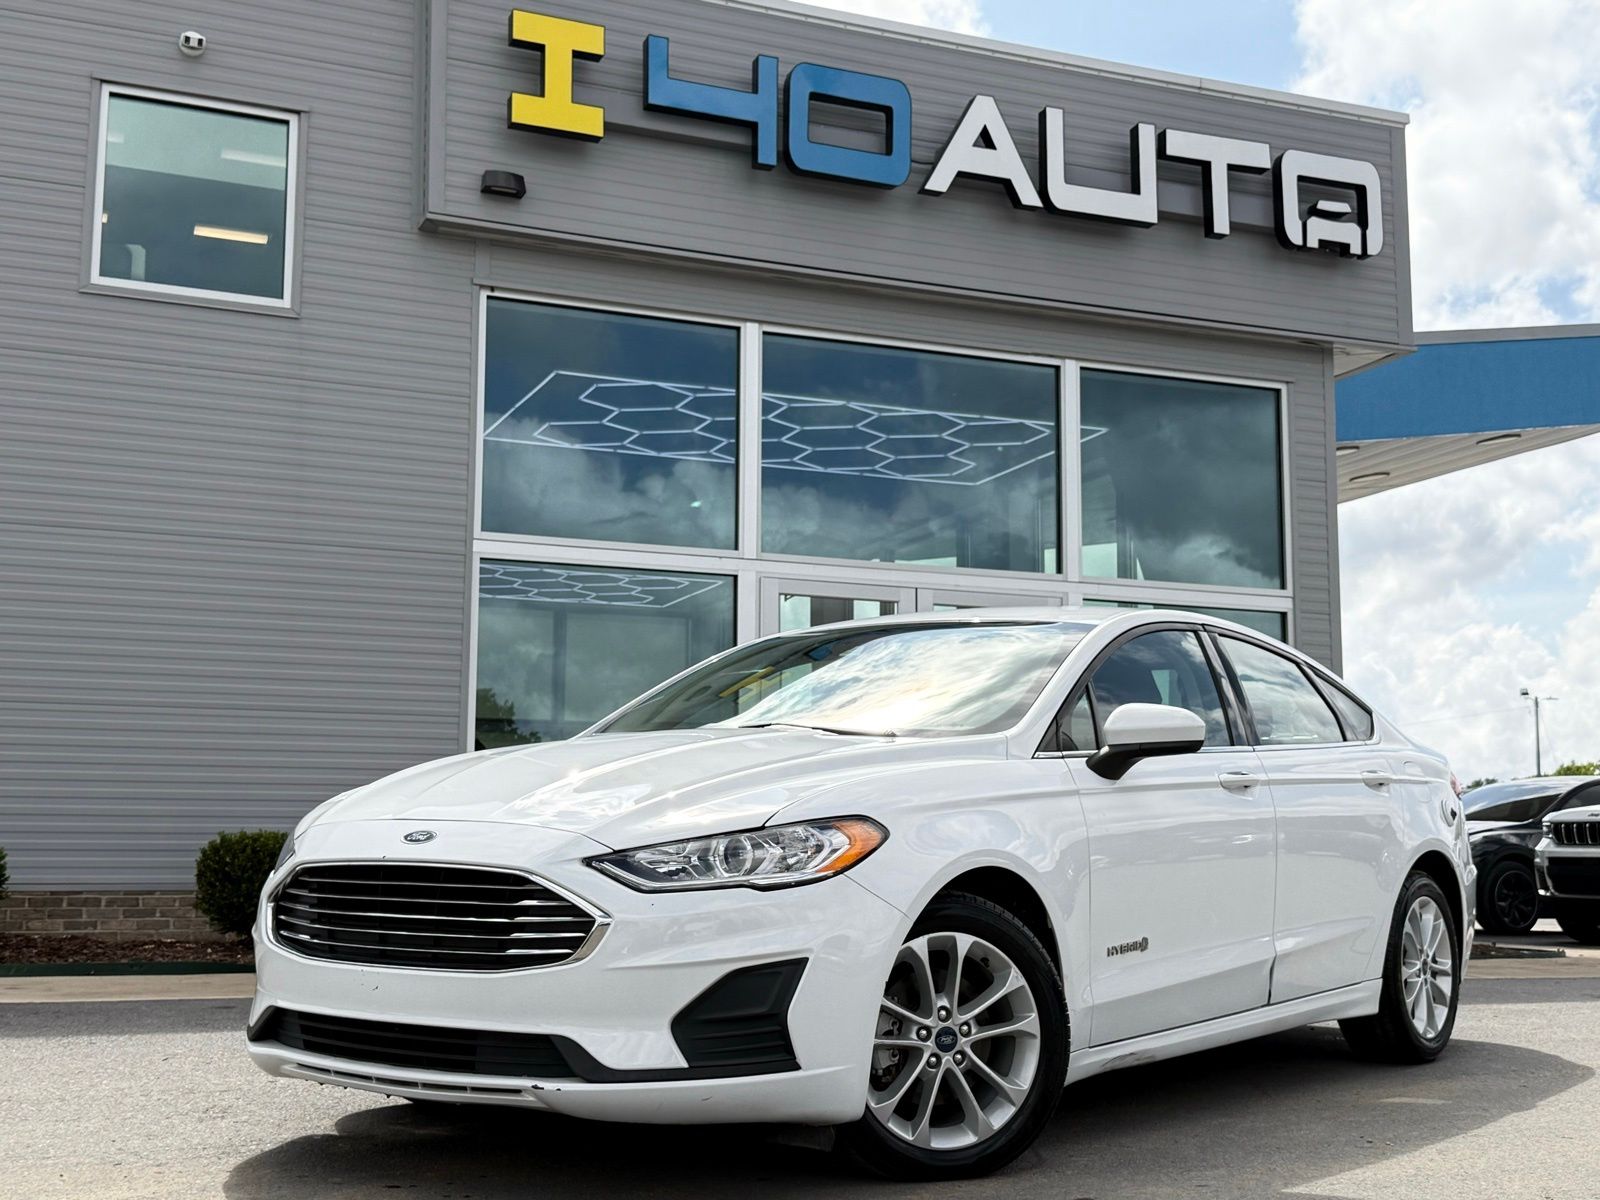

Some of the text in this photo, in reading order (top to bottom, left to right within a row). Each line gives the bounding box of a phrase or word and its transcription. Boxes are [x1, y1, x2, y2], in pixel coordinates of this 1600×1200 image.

[920, 95, 1384, 258] AUTO
[405, 830, 432, 842] Ford
[1106, 940, 1142, 957] HYBRID
